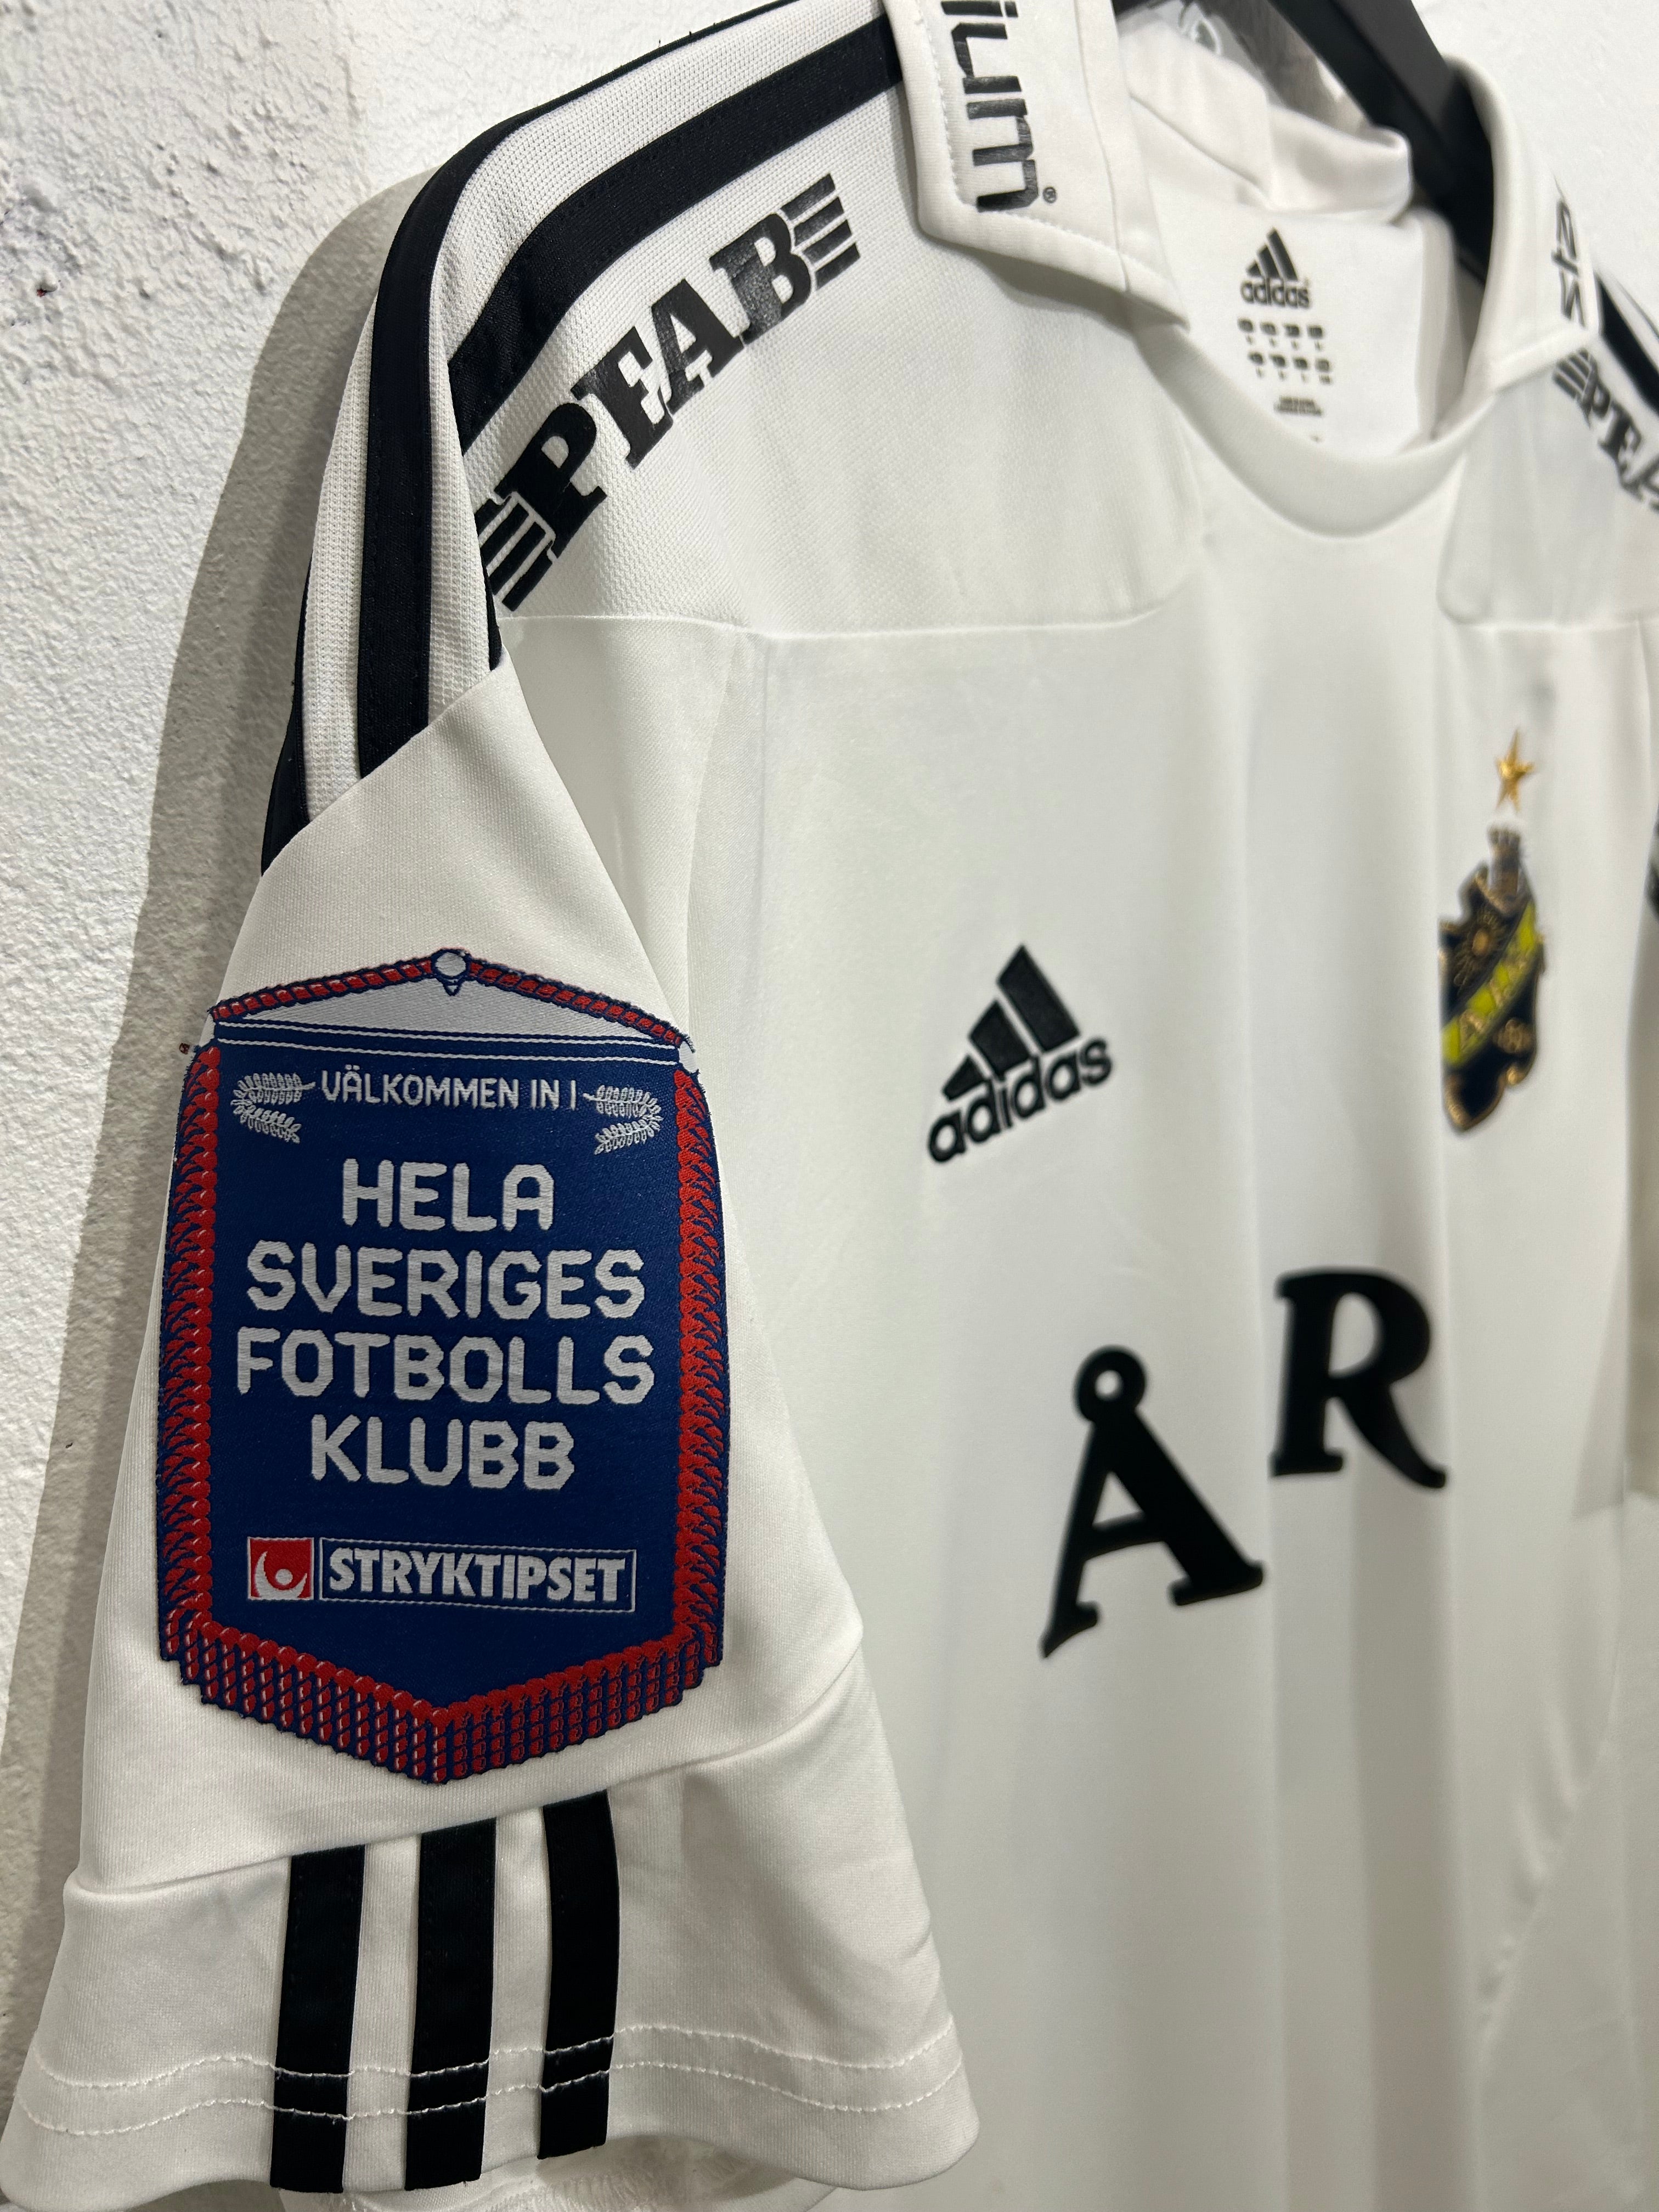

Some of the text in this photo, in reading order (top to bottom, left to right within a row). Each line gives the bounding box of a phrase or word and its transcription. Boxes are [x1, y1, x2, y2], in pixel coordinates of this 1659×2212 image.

[1240, 276, 1311, 309] adidas
[493, 213, 811, 559] PEAB
[320, 1064, 577, 1111] VÄLKOMMEN IN I
[928, 1036, 1114, 1164] adidas
[342, 1158, 554, 1232] HELA
[246, 1240, 646, 1319] SVERIGES
[236, 1327, 656, 1405] FOTBOLLS
[310, 1414, 575, 1491] KLUBB
[328, 1547, 627, 1603] STRYKTIPSET
